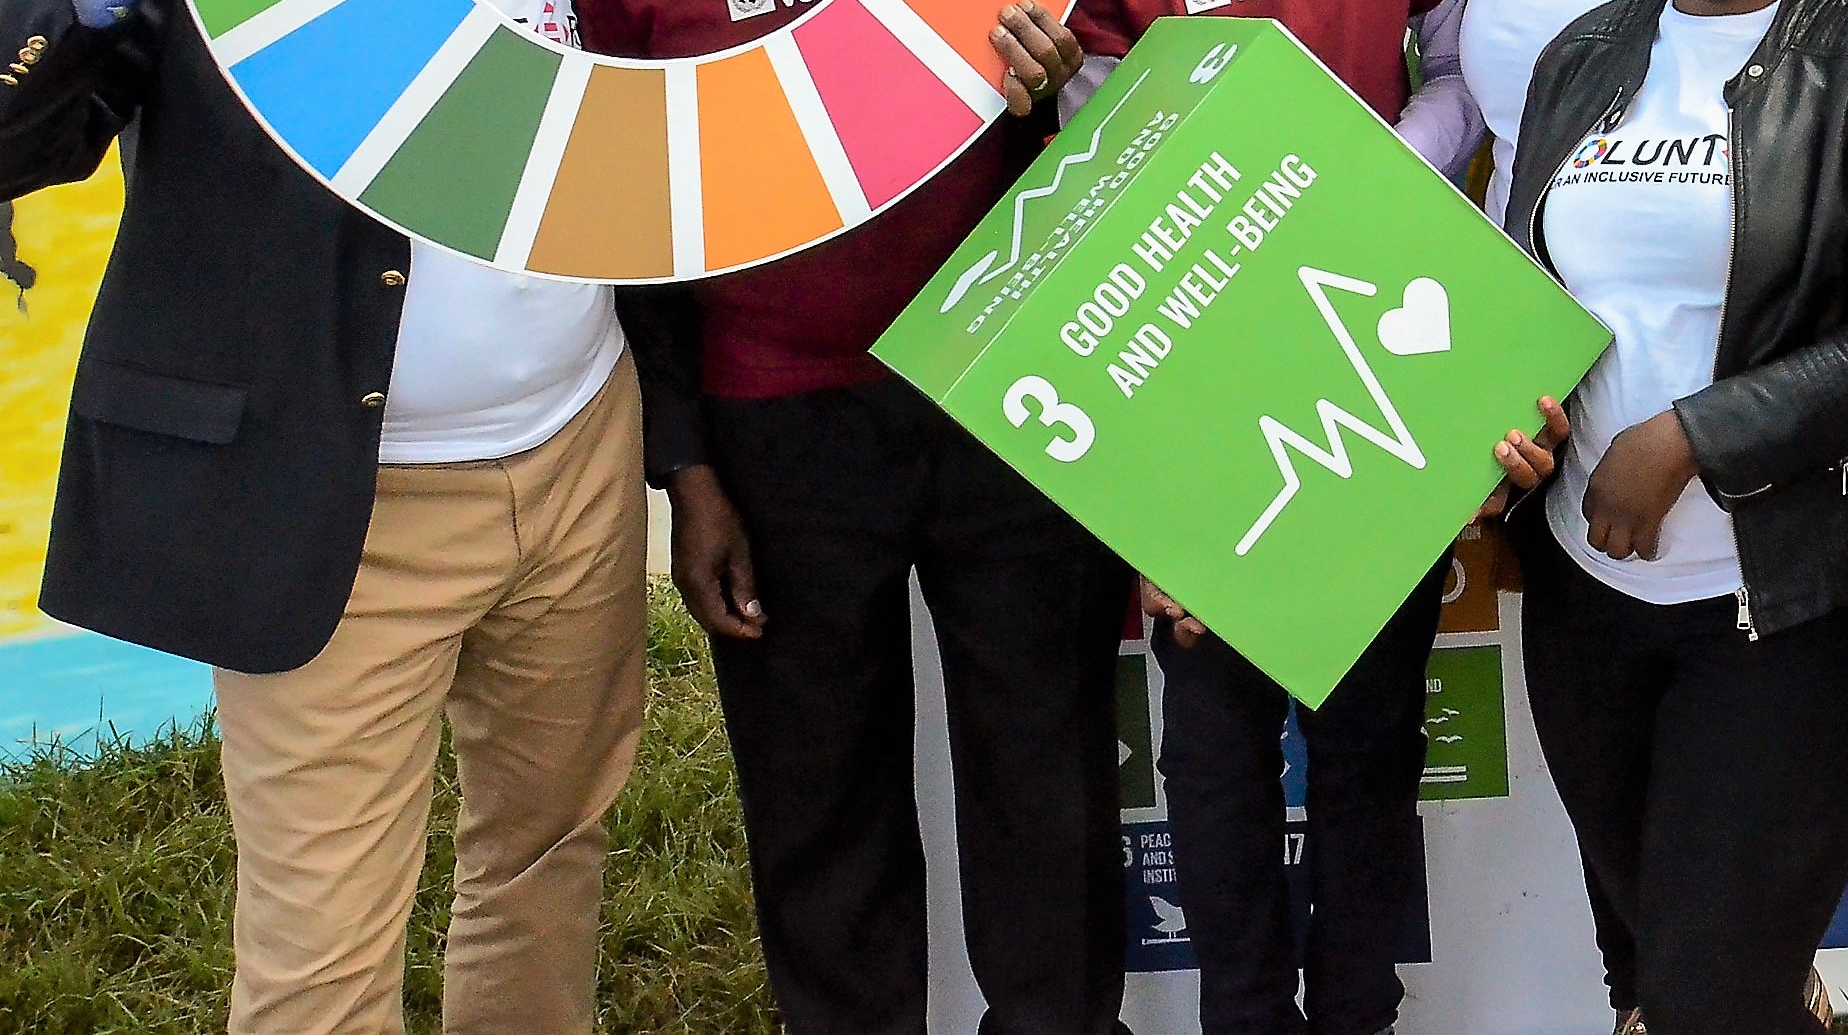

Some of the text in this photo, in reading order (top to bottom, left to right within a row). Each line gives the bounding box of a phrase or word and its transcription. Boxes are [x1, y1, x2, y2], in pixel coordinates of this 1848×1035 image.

[1563, 174, 1581, 185] AN
[1584, 171, 1664, 183] INCLUSIVE
[1060, 151, 1242, 357] GOOD HEALTH
[1106, 153, 1318, 399] AND WELL-BEING
[1002, 374, 1096, 463] 3
[1140, 833, 1171, 849] PEAC
[1142, 851, 1167, 866] AND
